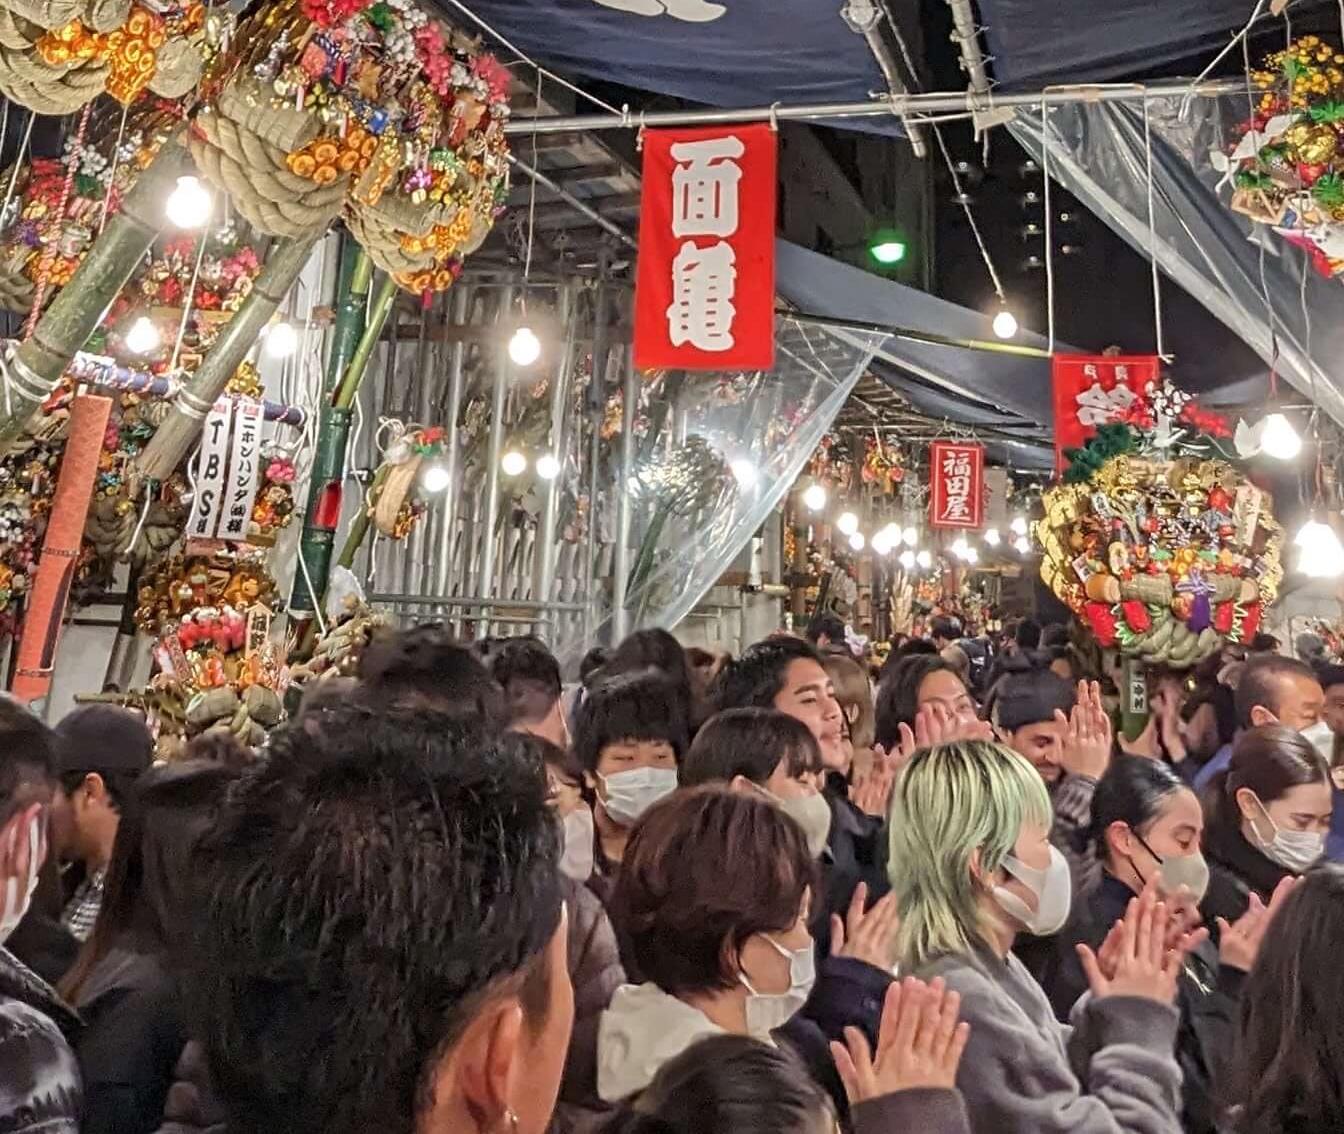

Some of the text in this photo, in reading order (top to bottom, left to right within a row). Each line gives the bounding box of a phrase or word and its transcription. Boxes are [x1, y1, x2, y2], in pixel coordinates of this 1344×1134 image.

[666, 135, 745, 352] 面亀
[941, 451, 971, 520] 福田屋
